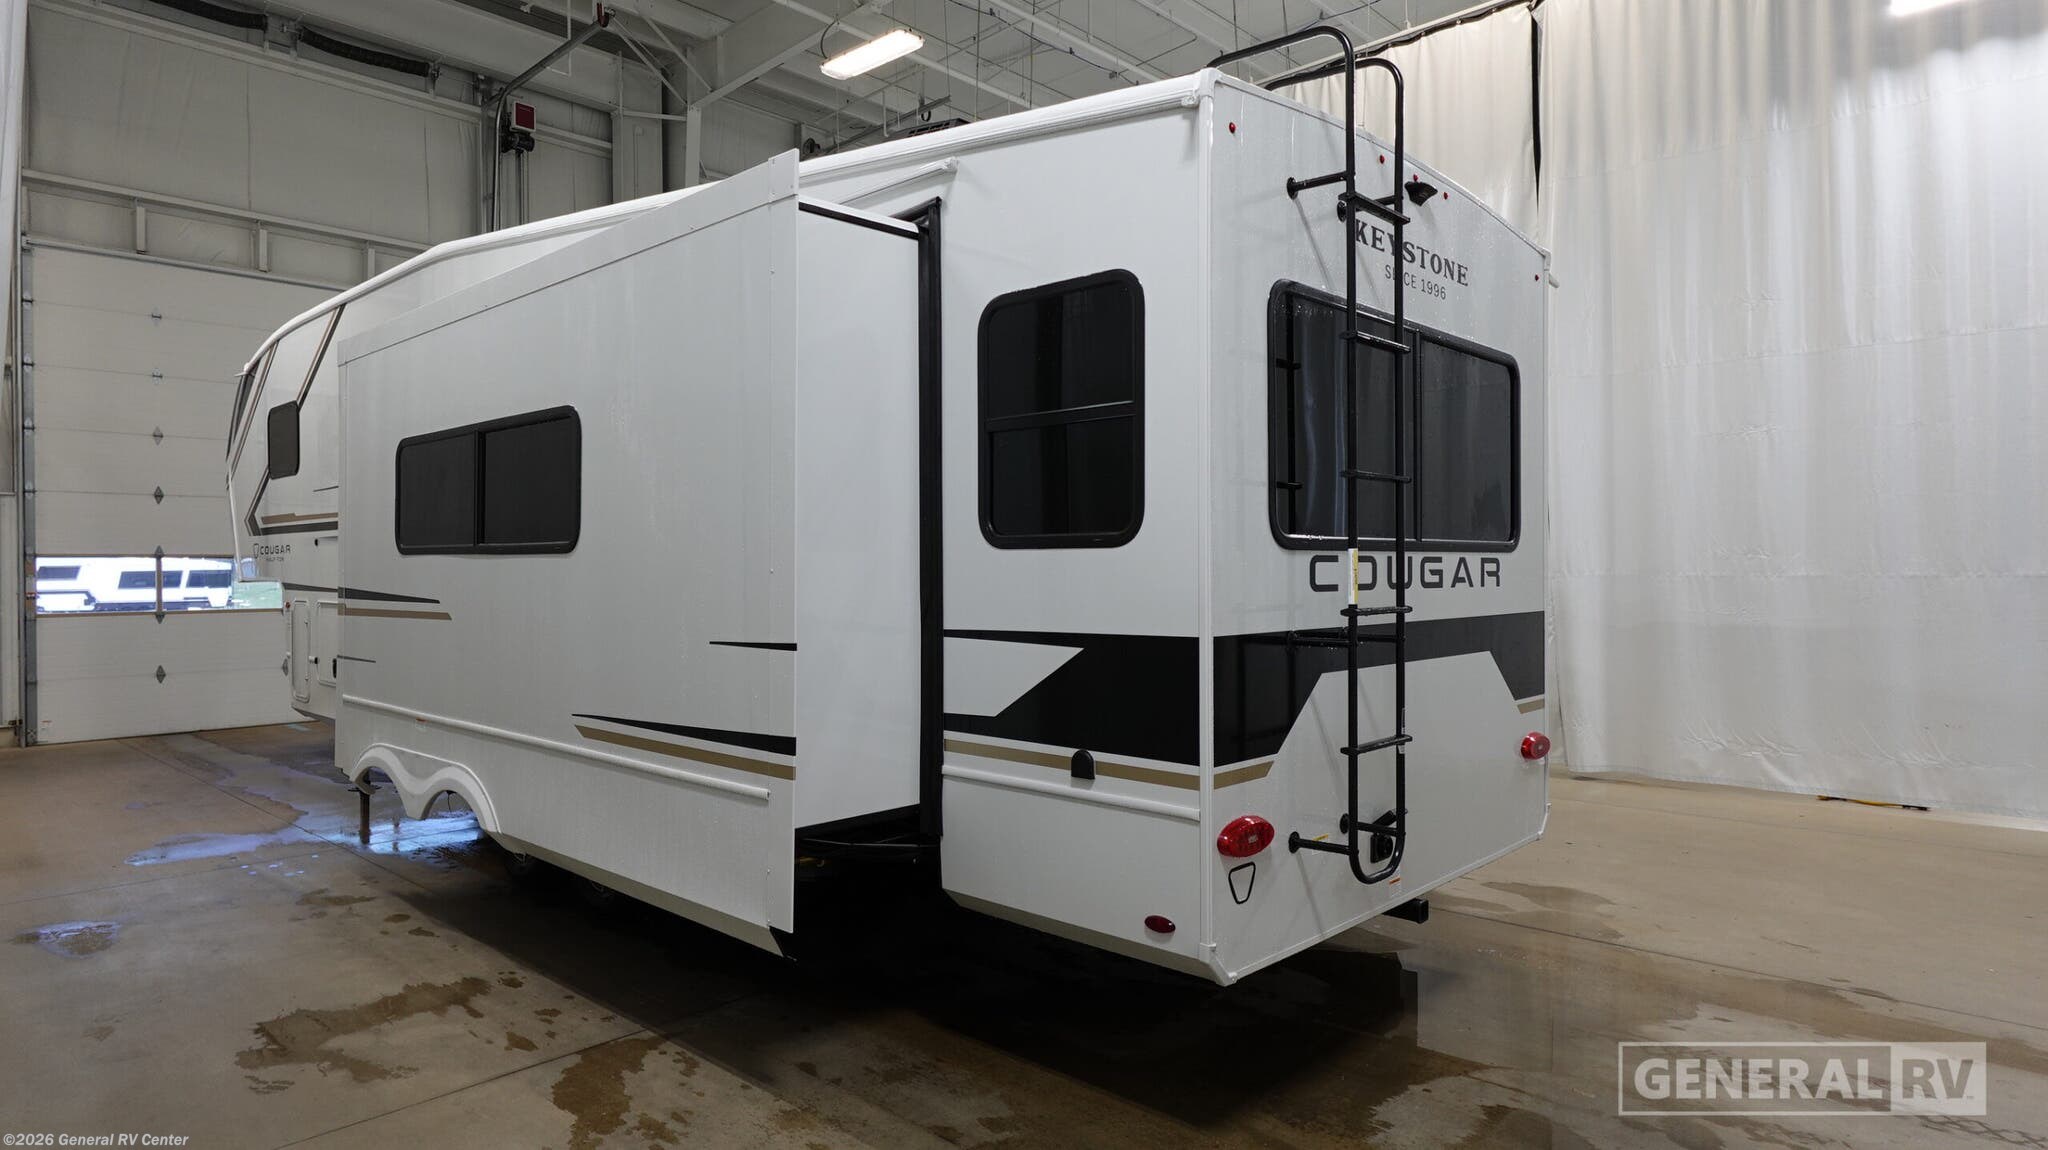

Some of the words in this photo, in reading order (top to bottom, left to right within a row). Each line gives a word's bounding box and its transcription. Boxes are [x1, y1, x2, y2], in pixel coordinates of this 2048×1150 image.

[1385, 264, 1416, 289] SICE
[1421, 279, 1446, 300] 1996
[260, 545, 291, 555] COUGAR
[1310, 554, 1500, 592] COUGAR
